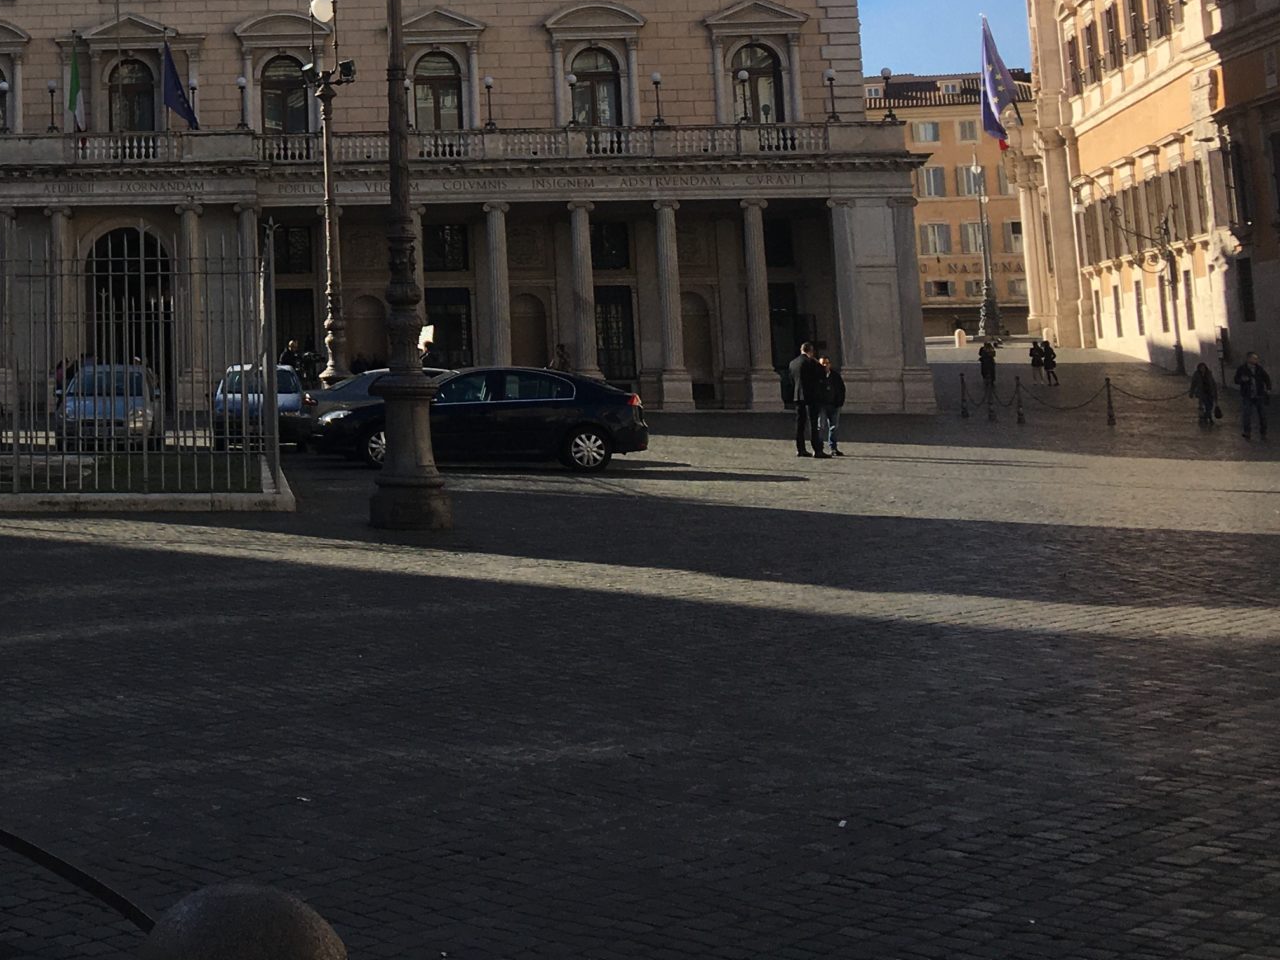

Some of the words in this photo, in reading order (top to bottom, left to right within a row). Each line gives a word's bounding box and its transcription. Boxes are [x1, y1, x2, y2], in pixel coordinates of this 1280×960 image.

[120, 180, 205, 193] EXORNANDAM
[278, 183, 339, 194] PORTIC
[364, 182, 420, 192] VEIOM
[442, 180, 508, 191] COLVMNIS
[531, 177, 595, 189] INSIGNEM
[619, 175, 722, 187] ADSTRVENDAM
[745, 174, 806, 186] CVRAVIT
[948, 262, 1025, 274] NAZONA
